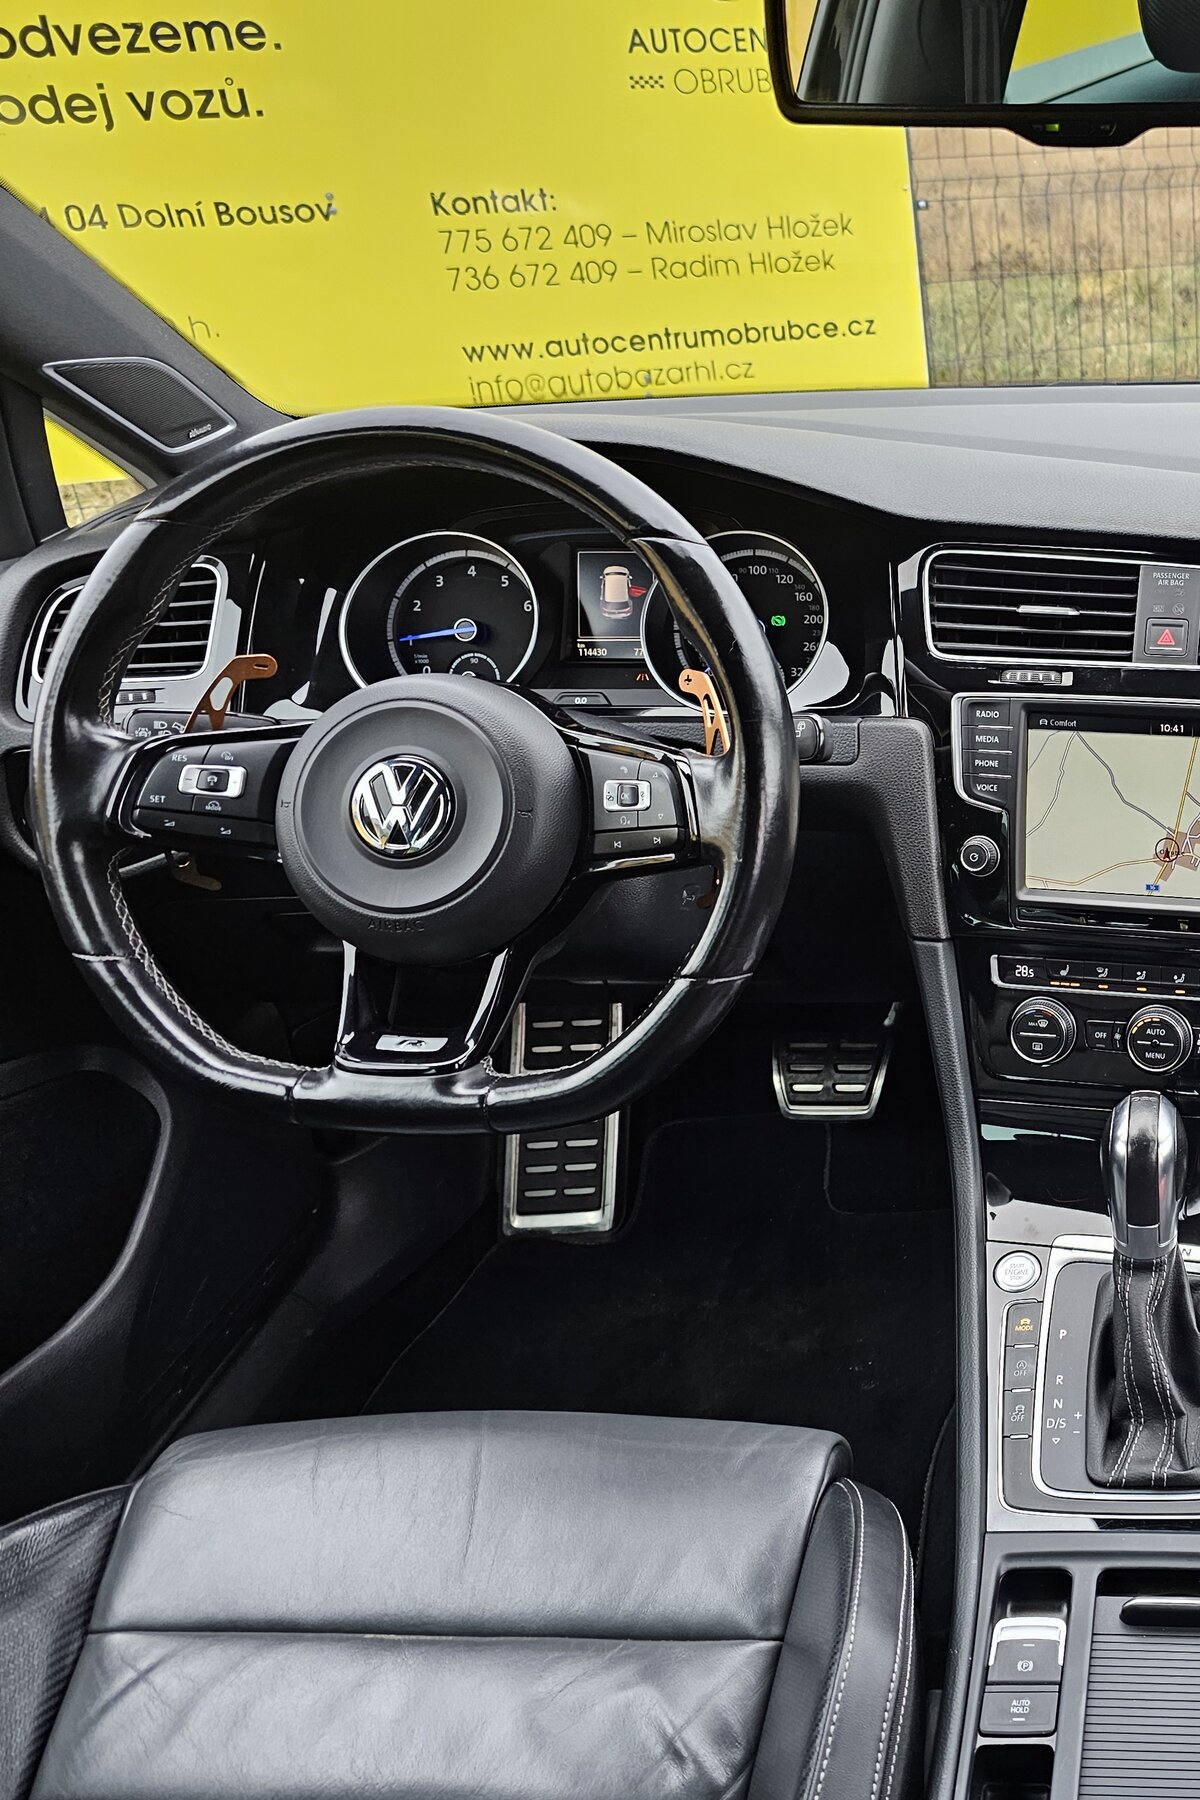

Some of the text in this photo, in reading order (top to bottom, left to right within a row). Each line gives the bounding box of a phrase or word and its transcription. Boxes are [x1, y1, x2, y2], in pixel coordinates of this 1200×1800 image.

[0, 14, 282, 59] odvezeme.
[674, 68, 771, 94] OBRUB
[0, 77, 264, 132] odej vozů.
[430, 187, 557, 216] Kontakt:
[64, 203, 109, 231] 04
[116, 200, 205, 229] Dolní
[213, 201, 333, 227] Bousov
[438, 228, 492, 254] 775
[502, 226, 553, 252] 672
[563, 223, 612, 249] 409
[645, 218, 757, 245] Miroslav
[766, 212, 854, 240] Hložek
[446, 264, 500, 292] 736
[509, 262, 560, 288] 672
[570, 259, 617, 285] 409
[651, 254, 741, 280] Radim
[748, 249, 836, 275] Hložek
[462, 317, 877, 364] www.autocentrumobrubce.cz
[468, 360, 756, 405] info@autobazarhl.cz
[467, 565, 477, 577] 4
[748, 565, 767, 575] 100
[776, 574, 794, 584] 120
[1153, 572, 1190, 580] PASSENGER
[436, 576, 445, 588] 3
[501, 576, 509, 588] 5
[795, 592, 813, 602] 160
[413, 600, 422, 612] 2
[523, 600, 532, 612] 6
[804, 615, 823, 624] 200
[579, 648, 608, 656] 114430
[791, 667, 805, 677] 32
[976, 710, 1000, 718] RADIO
[1050, 719, 1077, 727] Comfort
[1160, 724, 1184, 733] 10:41
[975, 735, 1000, 743] MEDIA
[172, 754, 188, 762] RES
[975, 760, 999, 768] PHONE
[976, 784, 998, 792] VOICE
[149, 795, 166, 803] SET
[1146, 1028, 1166, 1036] AUTO
[1059, 1329, 1067, 1340] P
[1056, 1375, 1064, 1385] R
[1053, 1399, 1063, 1409] N
[1046, 1417, 1066, 1429] D/S
